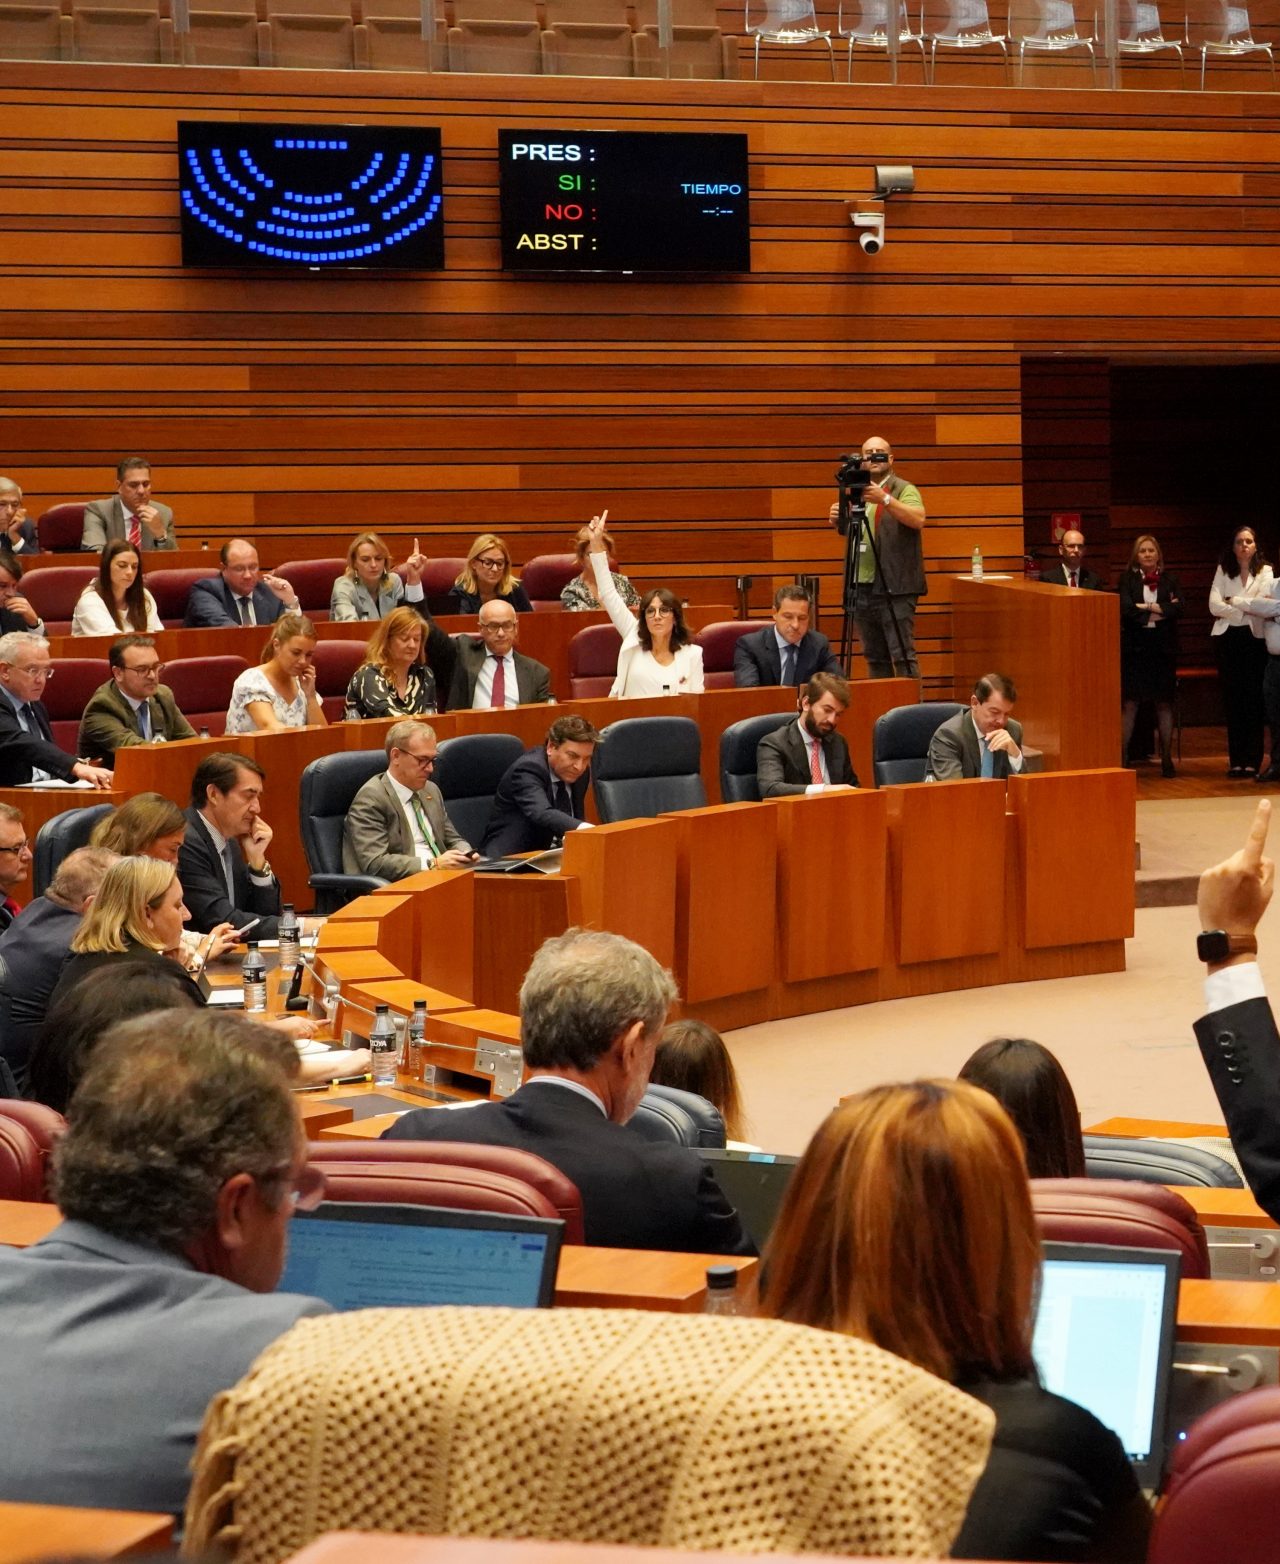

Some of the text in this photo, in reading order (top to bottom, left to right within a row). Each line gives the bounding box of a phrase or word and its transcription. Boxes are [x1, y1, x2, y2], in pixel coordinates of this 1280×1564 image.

[511, 143, 582, 162] PRES
[558, 174, 581, 191] SI
[680, 183, 742, 196] TIEMPO
[545, 204, 583, 220] NO
[516, 233, 585, 251] ABST
